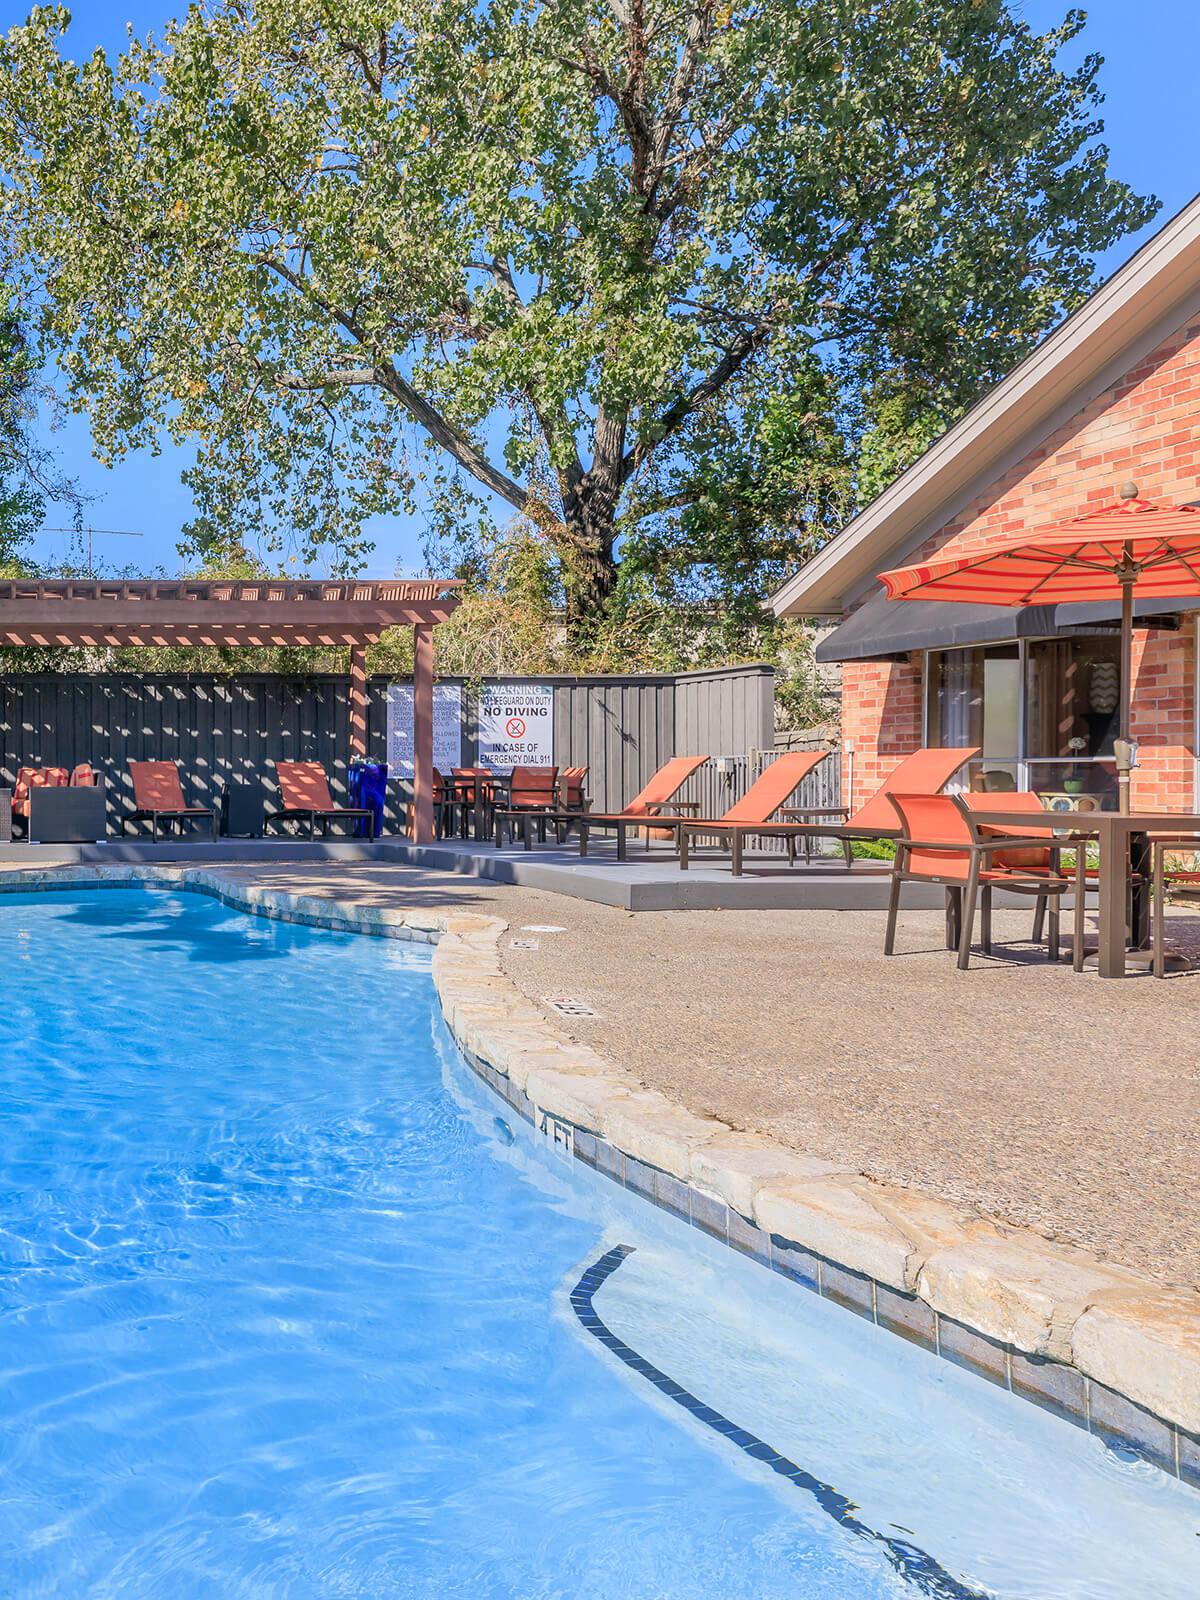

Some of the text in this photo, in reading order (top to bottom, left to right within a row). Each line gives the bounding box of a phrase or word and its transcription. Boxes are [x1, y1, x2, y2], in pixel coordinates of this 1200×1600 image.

[490, 685, 542, 694] WARNING
[525, 696, 534, 705] ON
[536, 696, 551, 705] DUTY
[483, 707, 548, 716] NO DIVING
[492, 743, 538, 752] IN CASE OF
[480, 754, 551, 764] EMERGENCY DIAL 911
[539, 1113, 572, 1151] 4 FT
